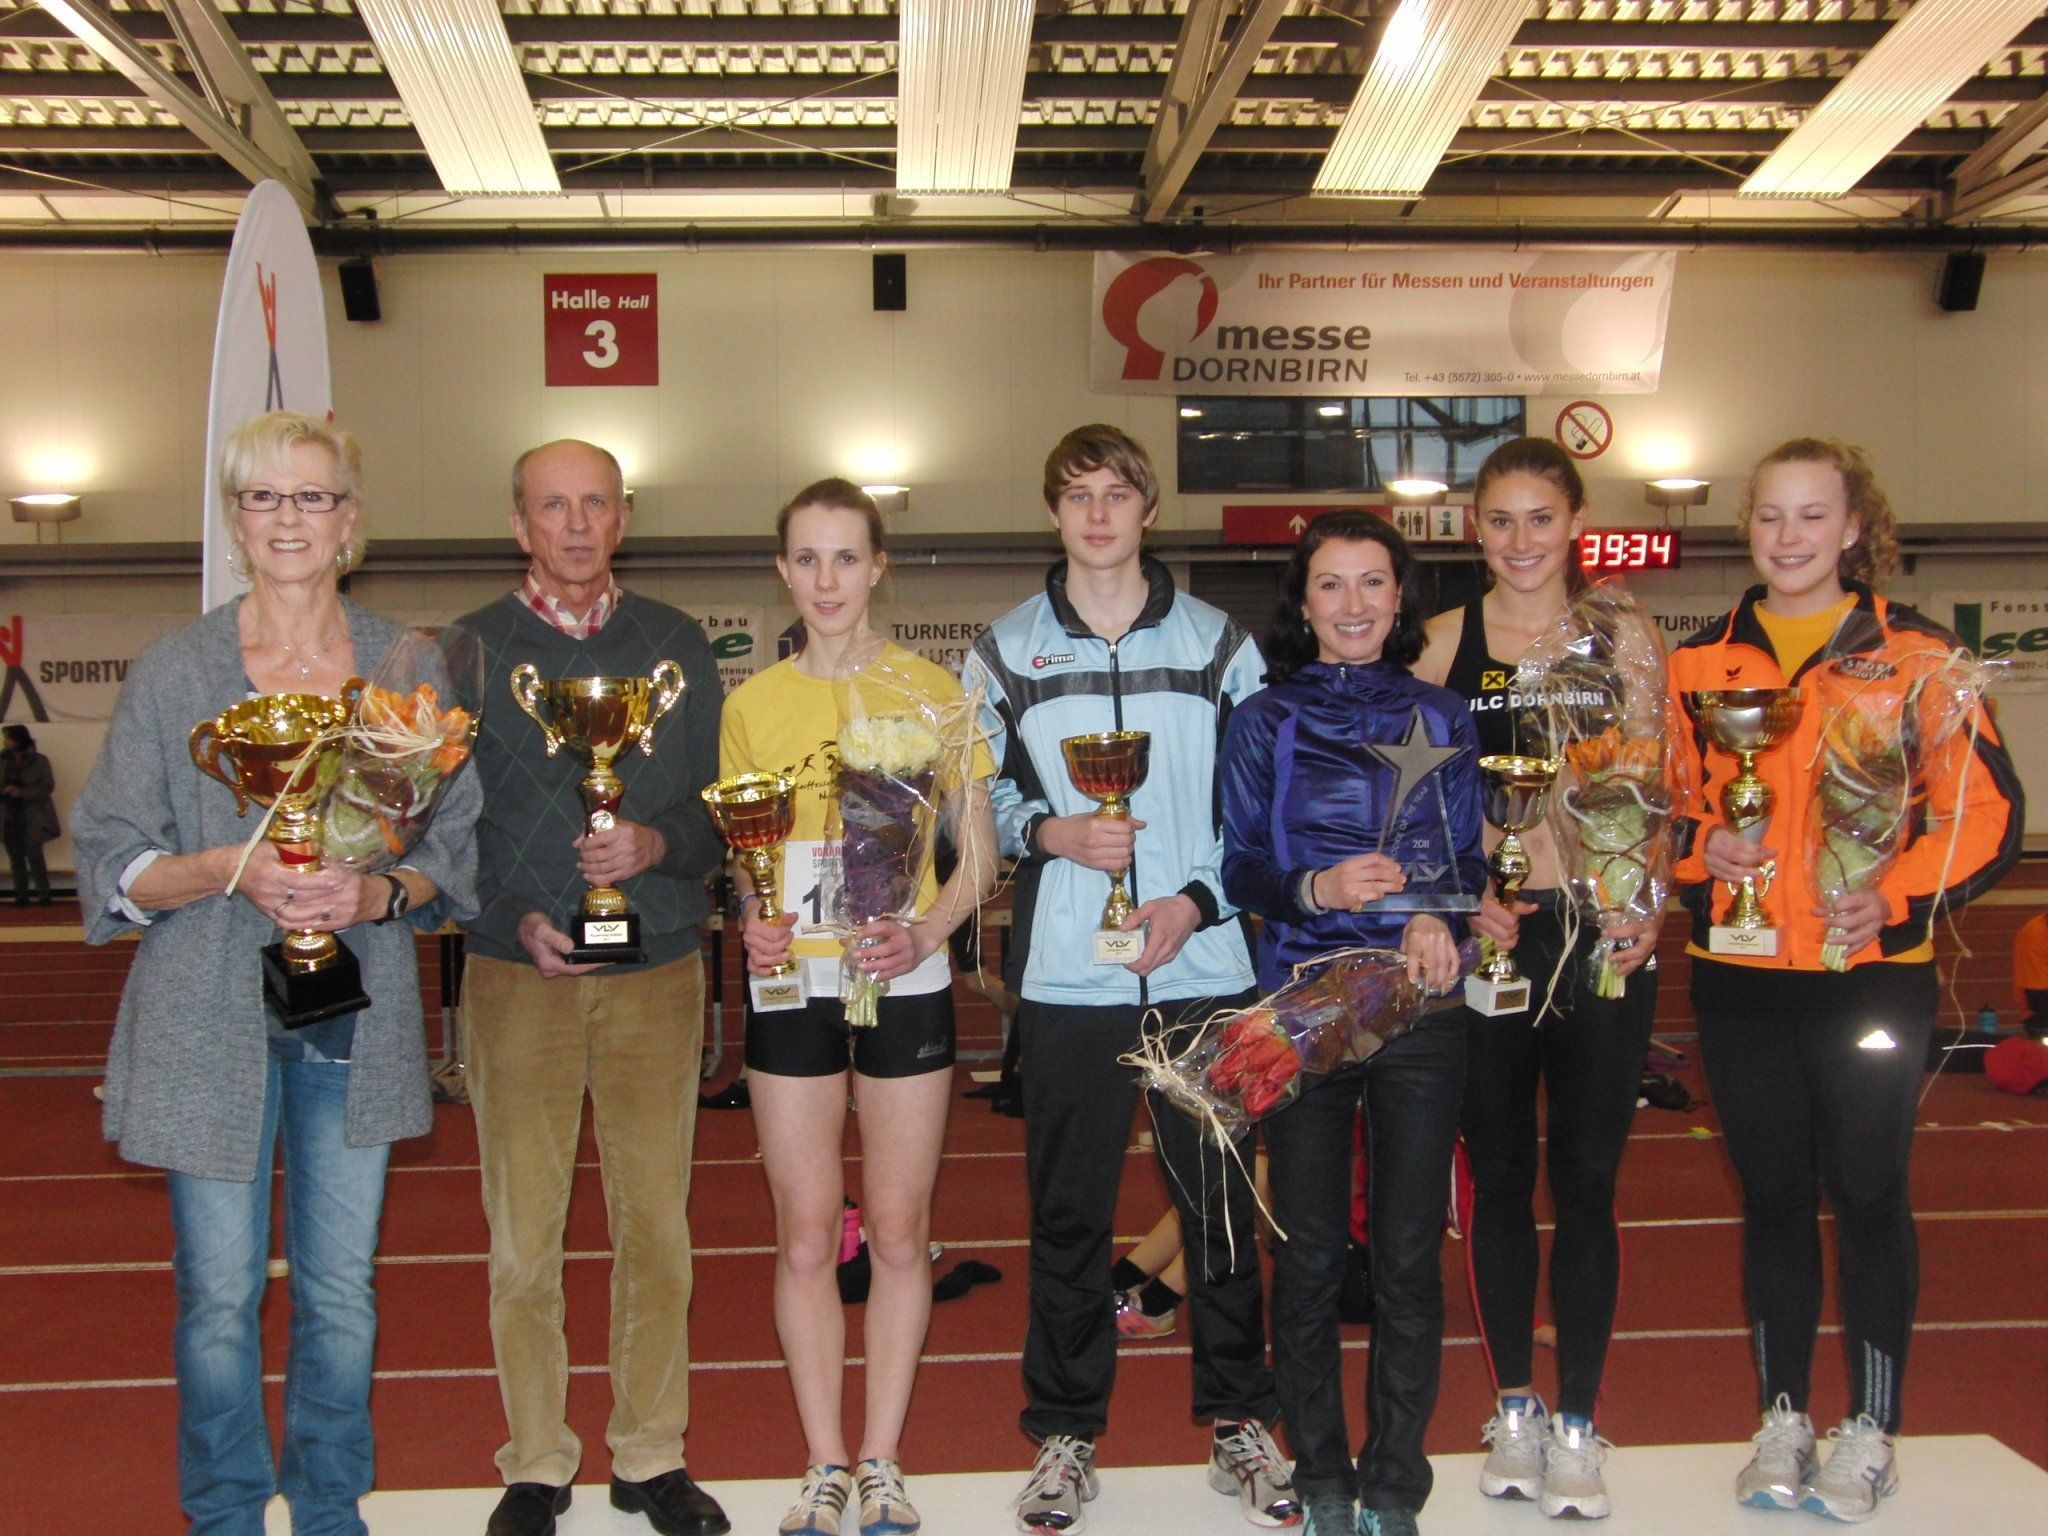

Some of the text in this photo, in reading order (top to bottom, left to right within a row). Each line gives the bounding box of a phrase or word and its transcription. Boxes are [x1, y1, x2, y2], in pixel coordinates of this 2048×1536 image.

[1258, 272, 1655, 292] Ihr Partner für Messen und Veranstaltungen
[552, 289, 649, 309] Halle Hall
[582, 319, 620, 369] 3
[1216, 325, 1372, 351] messe
[1173, 357, 1369, 383] DORNBIRN
[1404, 372, 1421, 383] Tel.
[1424, 372, 1445, 383] +43
[1448, 372, 1481, 384] (5572)
[1483, 372, 1514, 383] 305-0
[1582, 534, 1672, 566] 39:34
[40, 659, 134, 683] SPORTV
[1412, 839, 1430, 849] 2011
